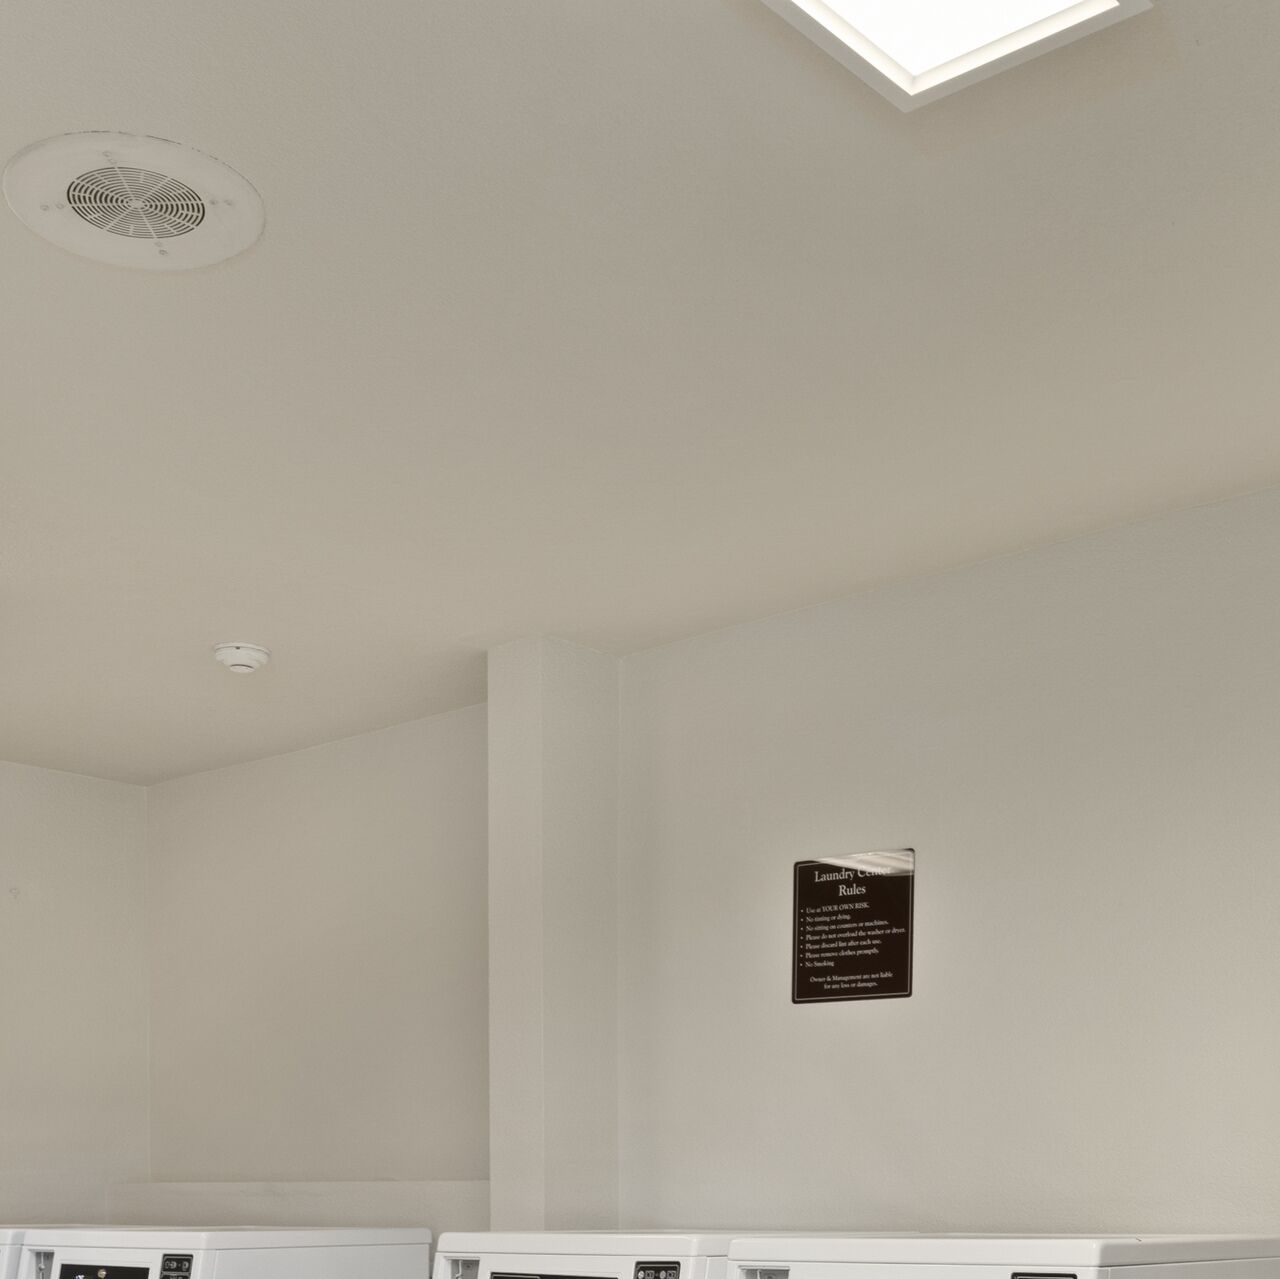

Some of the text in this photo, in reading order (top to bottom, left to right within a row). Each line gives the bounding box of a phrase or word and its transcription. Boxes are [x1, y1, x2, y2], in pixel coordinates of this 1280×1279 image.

[814, 868, 855, 882] Laundry
[839, 883, 866, 896] Rules
[822, 904, 838, 912] YOUR
[832, 974, 862, 982] Management
